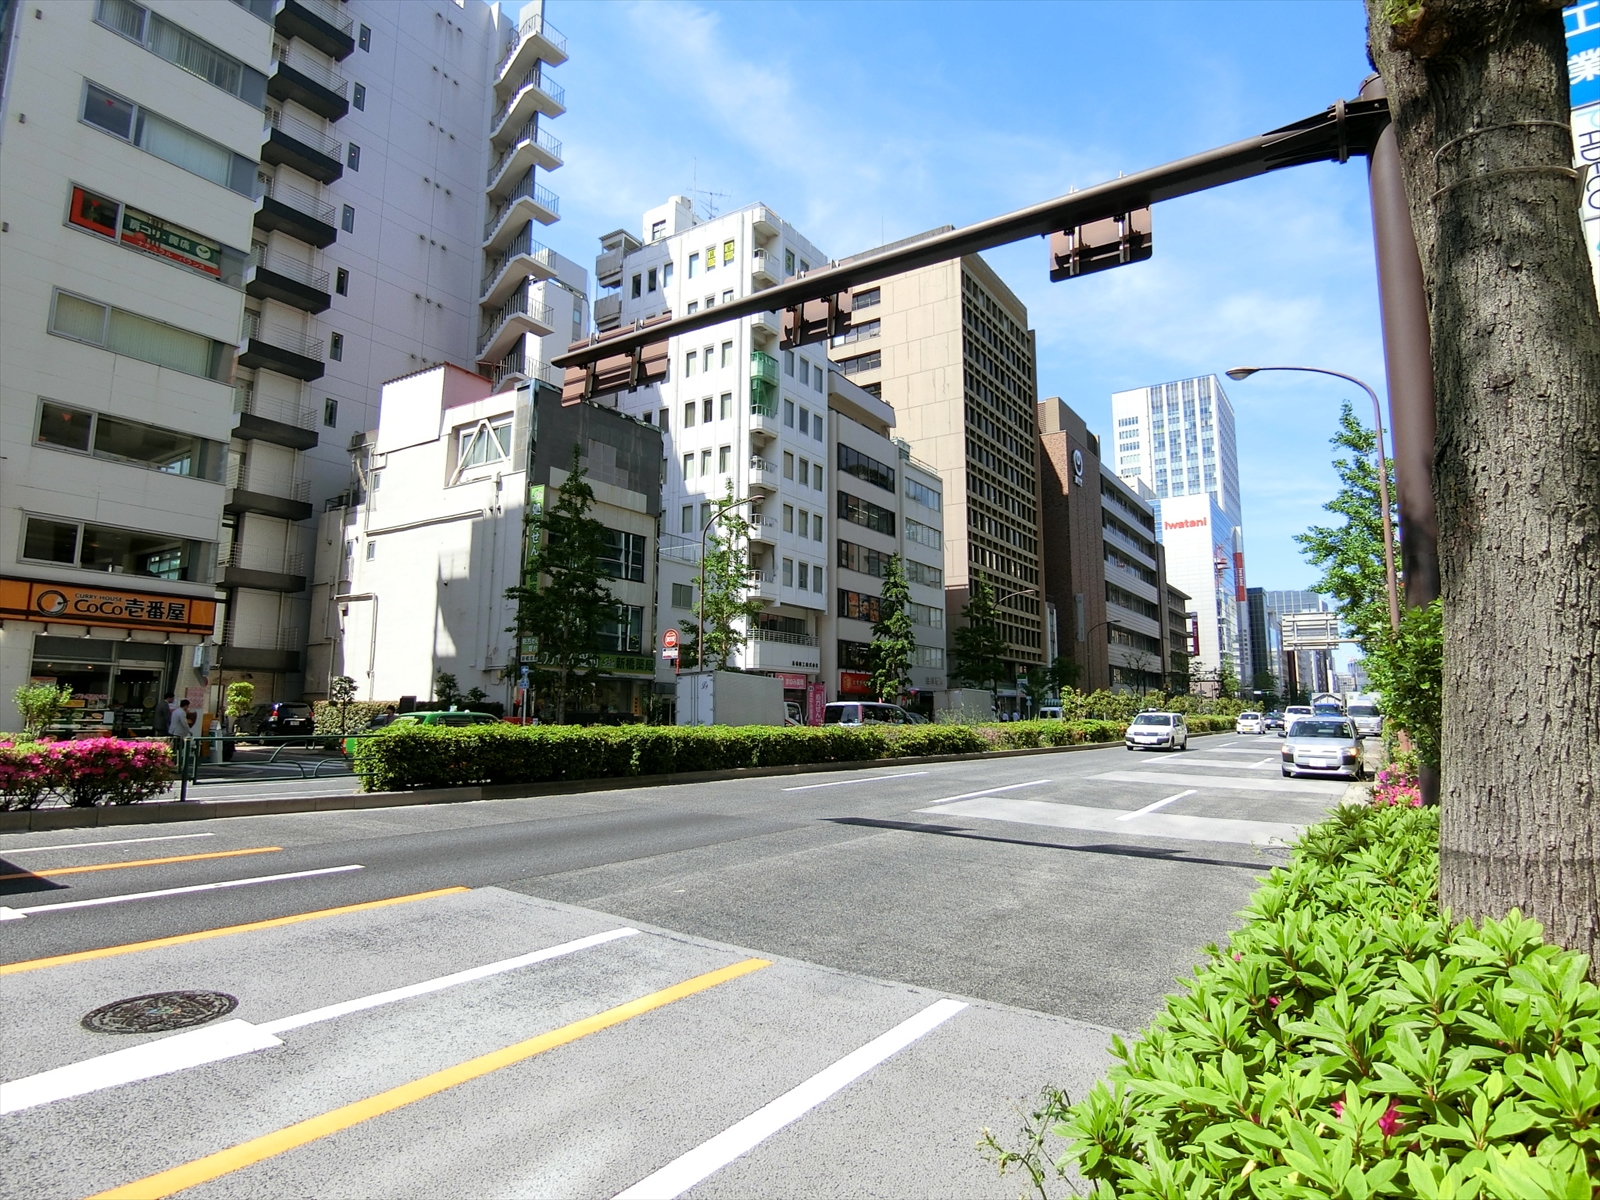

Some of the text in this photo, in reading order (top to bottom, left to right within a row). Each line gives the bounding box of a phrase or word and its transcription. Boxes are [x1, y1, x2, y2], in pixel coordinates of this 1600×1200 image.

[1164, 517, 1207, 530] Iwatani
[616, 656, 654, 672] 新橋薬局
